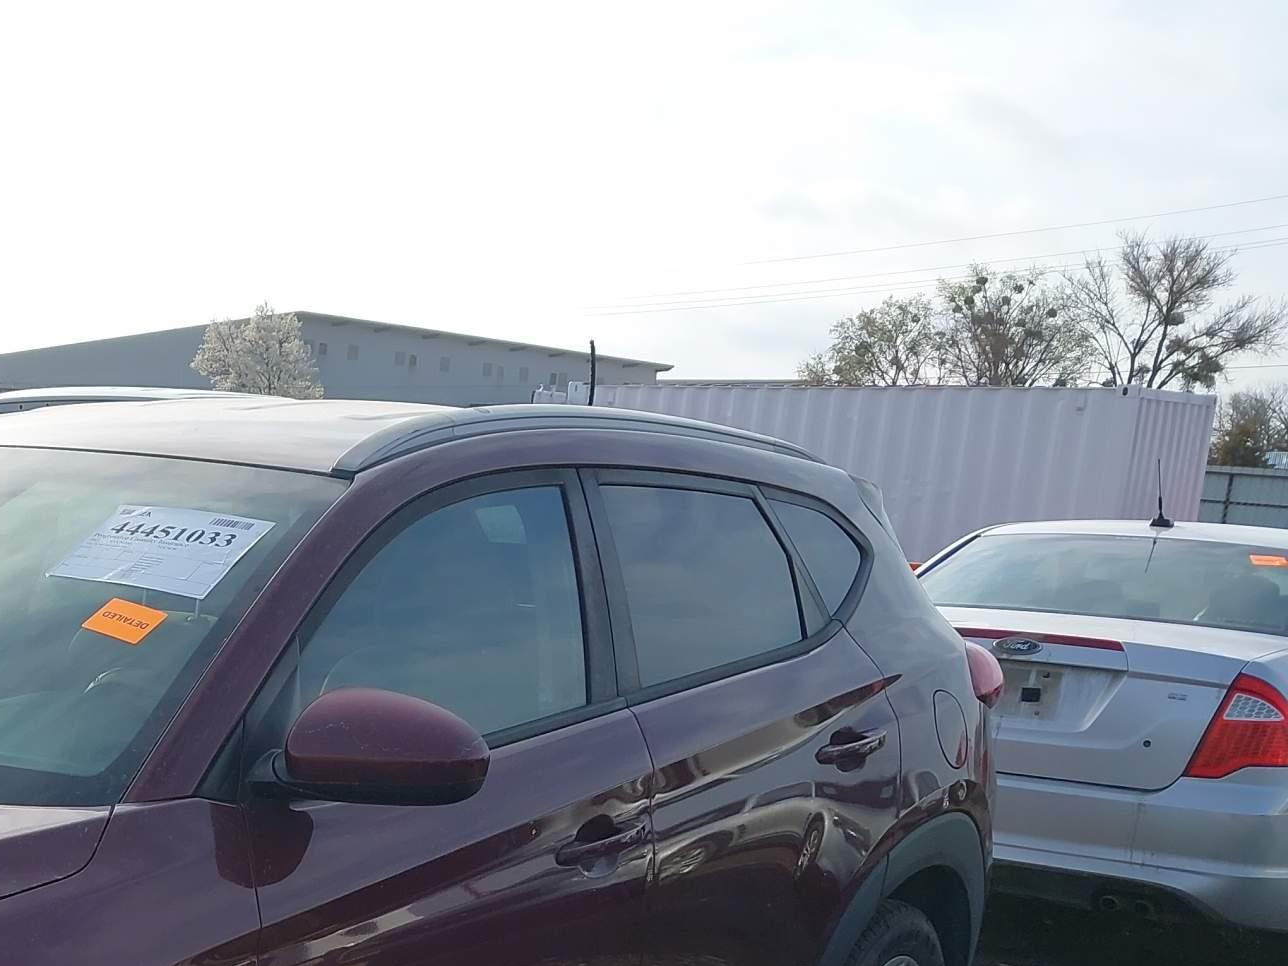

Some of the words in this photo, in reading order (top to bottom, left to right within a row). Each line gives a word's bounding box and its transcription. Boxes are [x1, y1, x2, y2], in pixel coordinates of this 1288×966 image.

[110, 521, 237, 548] 44451033
[102, 611, 150, 630] DETAILED
[1003, 640, 1031, 650] Ford
